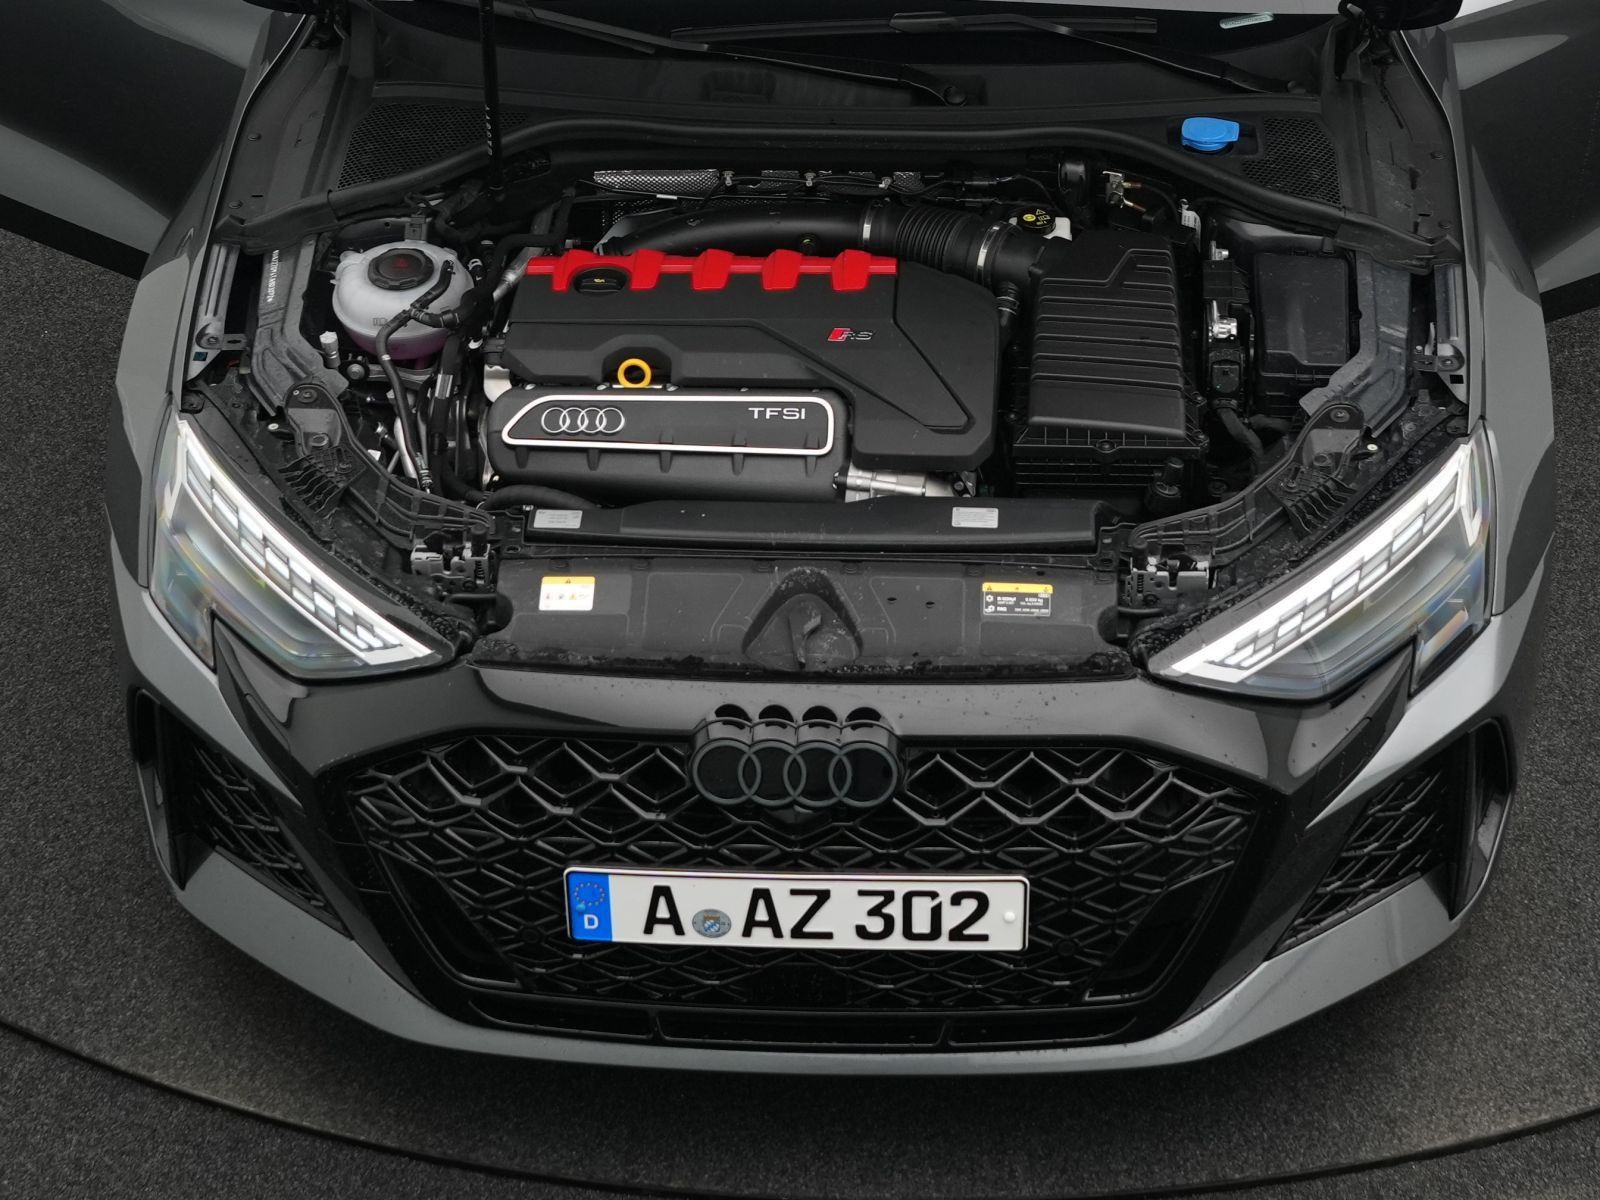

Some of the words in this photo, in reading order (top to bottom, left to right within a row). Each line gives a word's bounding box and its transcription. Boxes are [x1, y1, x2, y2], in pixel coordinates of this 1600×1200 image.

[828, 328, 873, 342] RS
[748, 407, 806, 420] TFSI
[643, 885, 686, 936] A
[741, 888, 834, 940] AZ
[855, 890, 990, 942] 302
[583, 914, 599, 930] D
